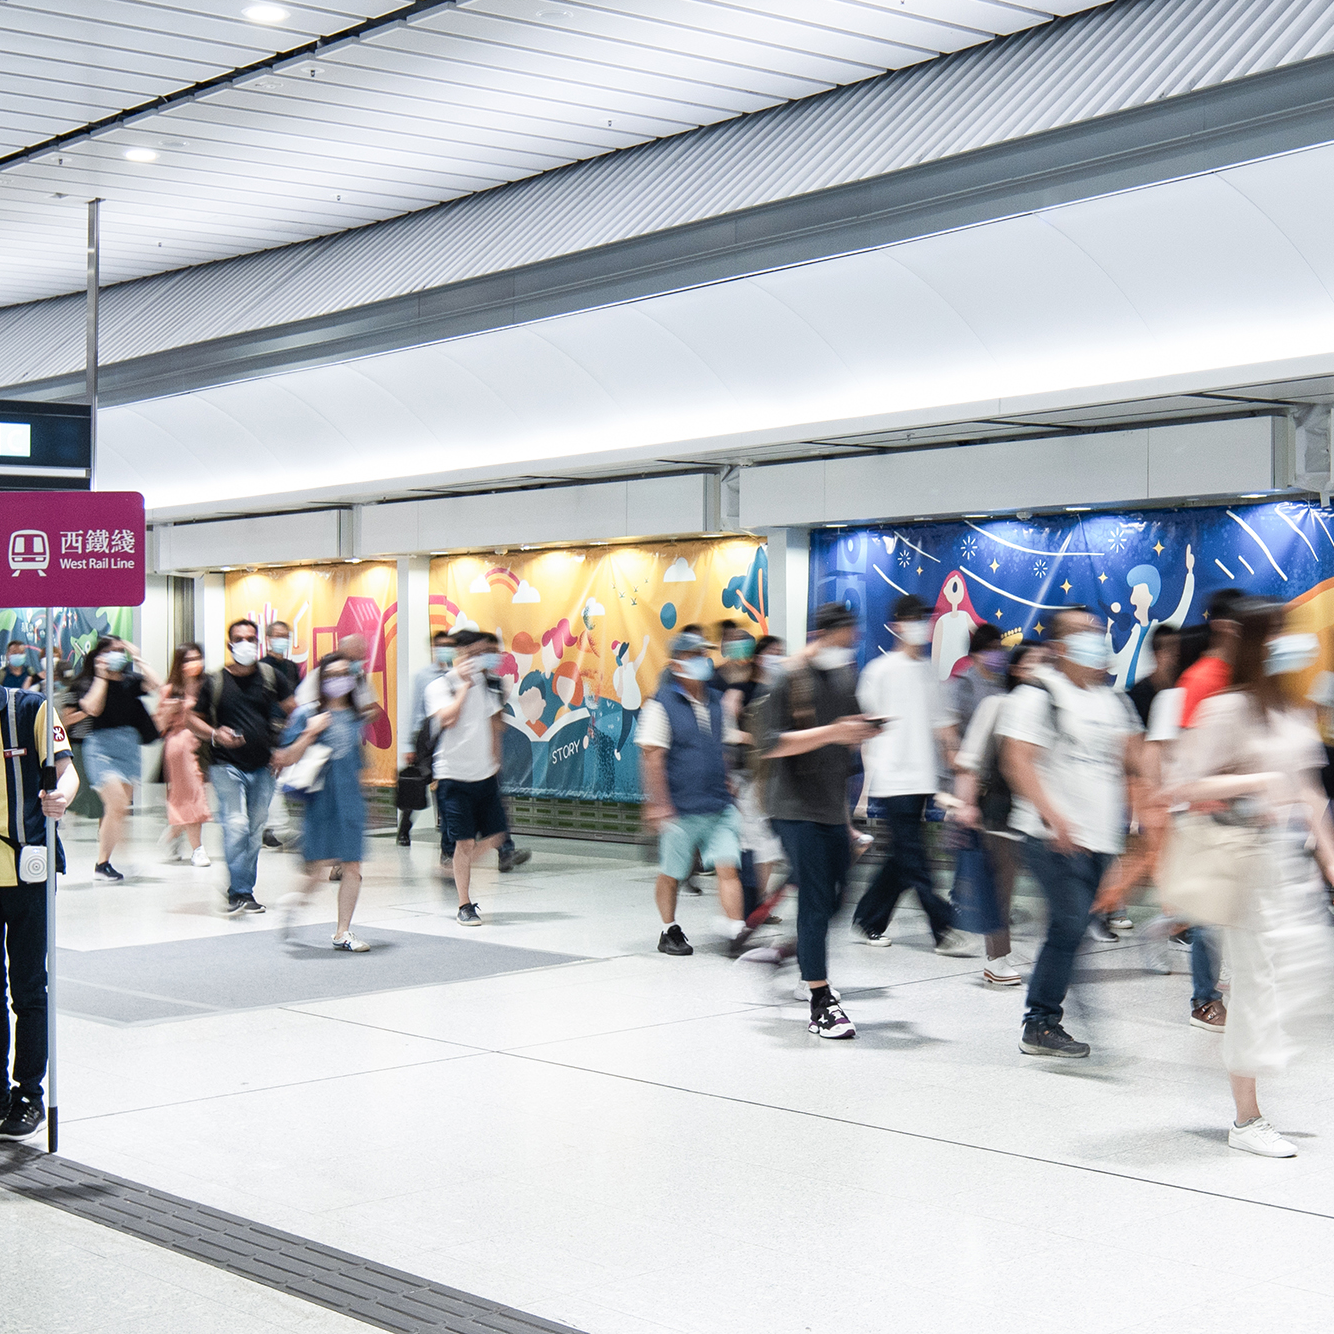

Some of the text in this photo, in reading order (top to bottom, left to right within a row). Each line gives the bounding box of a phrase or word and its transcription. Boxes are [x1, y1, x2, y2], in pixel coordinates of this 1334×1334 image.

[7, 429, 23, 453] C
[59, 529, 135, 554] 西鐵綫
[59, 557, 135, 569] West Rail Line
[552, 739, 581, 764] STORY
